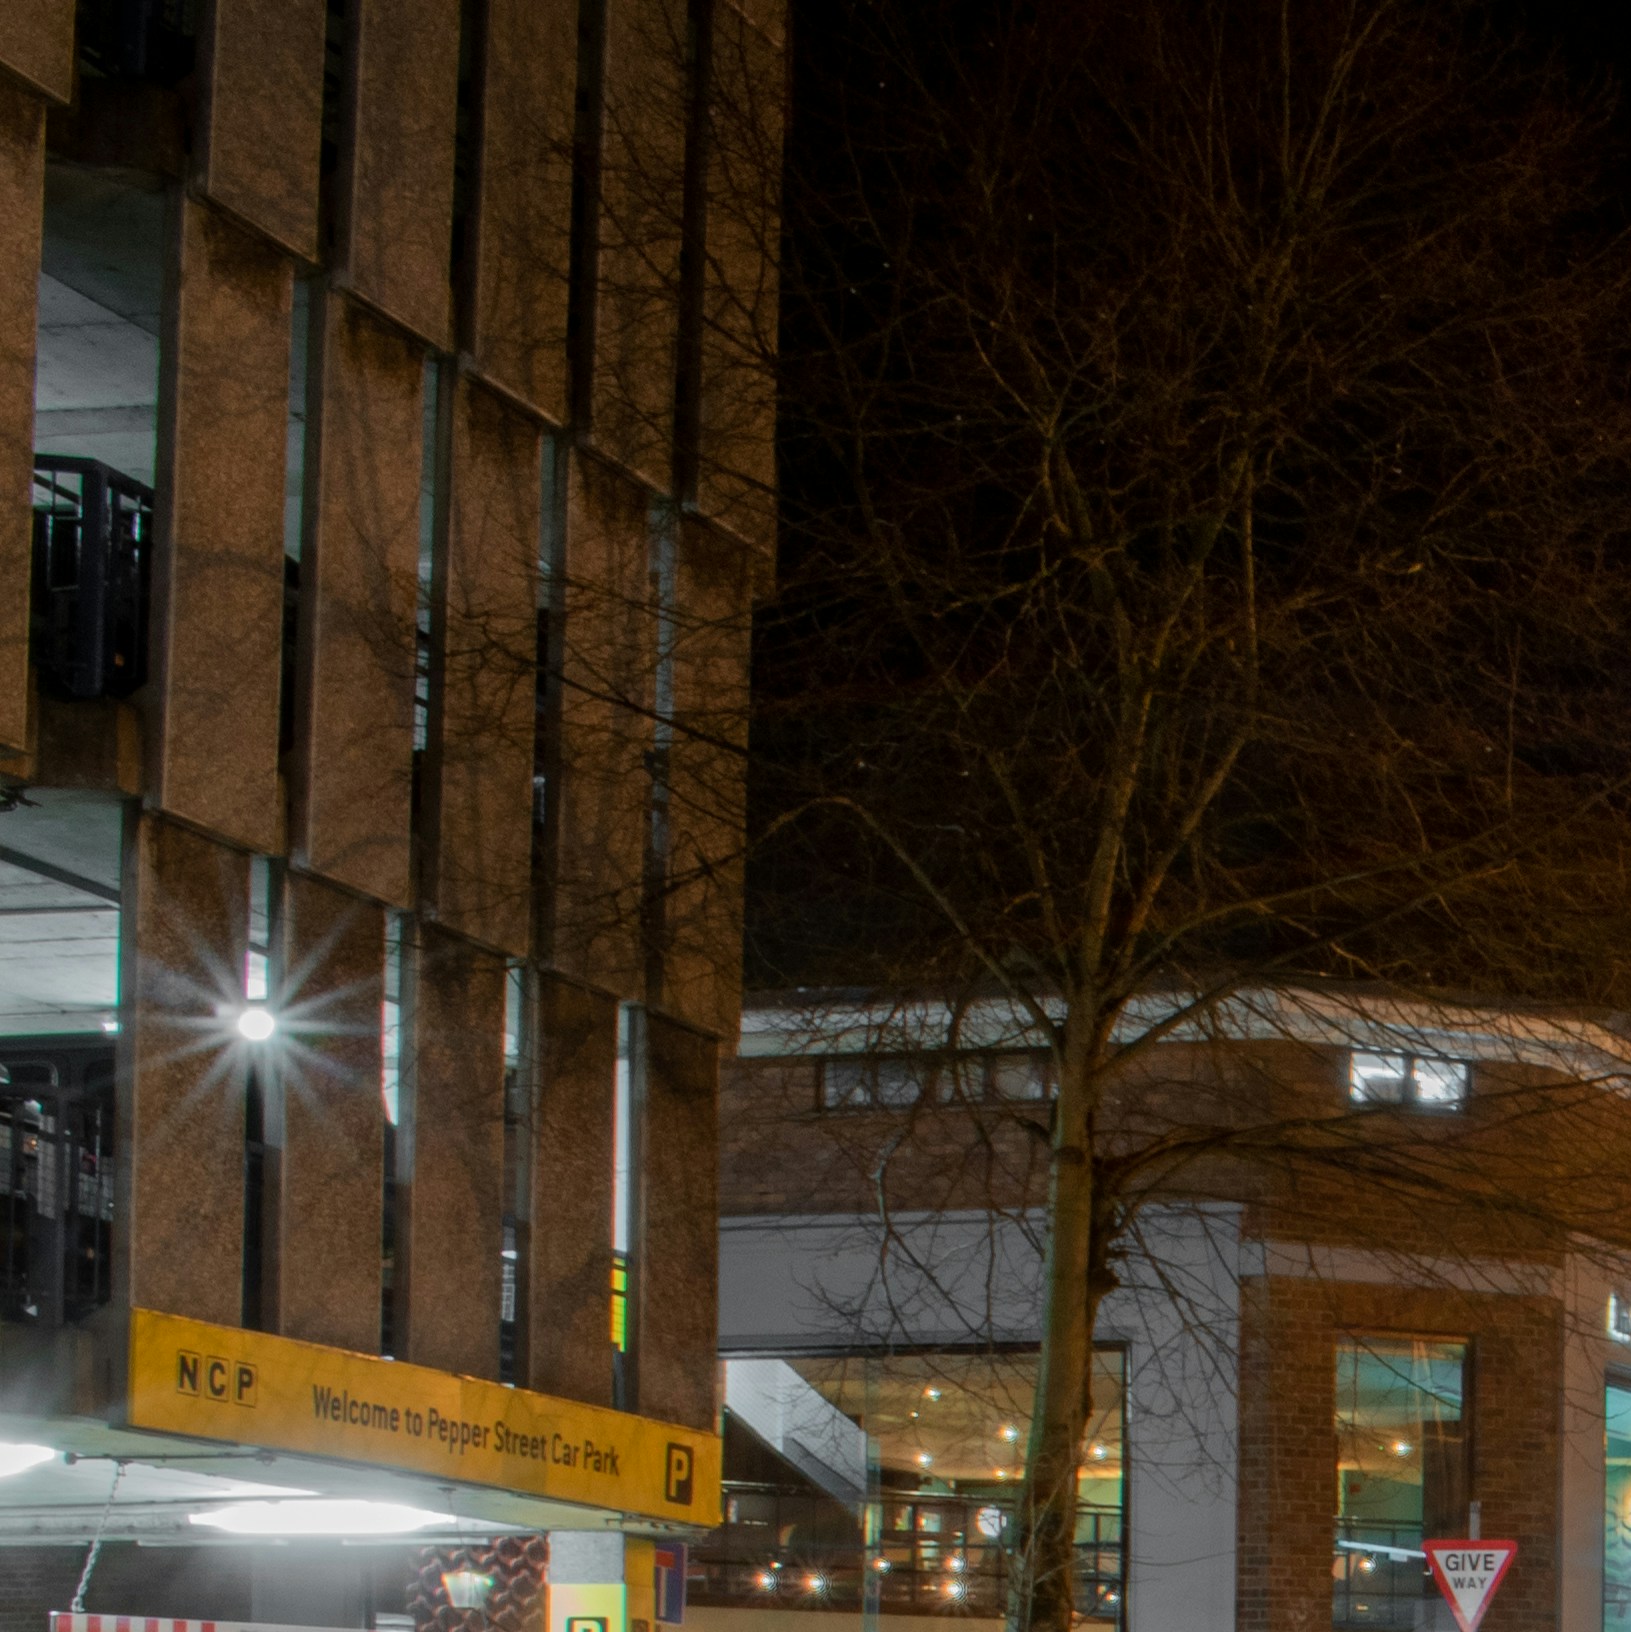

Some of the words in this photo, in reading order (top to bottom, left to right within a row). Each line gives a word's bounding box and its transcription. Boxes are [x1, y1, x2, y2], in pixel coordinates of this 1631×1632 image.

[177, 1354, 256, 1400] NCP
[312, 1383, 400, 1432] Welcome
[404, 1406, 423, 1437] to
[427, 1407, 491, 1456] Pepper
[493, 1421, 548, 1461] Street
[550, 1432, 581, 1468] Car
[583, 1439, 621, 1477] Park
[668, 1446, 690, 1497] P
[1445, 1553, 1495, 1572] GIVE
[1453, 1577, 1487, 1589] WAY
